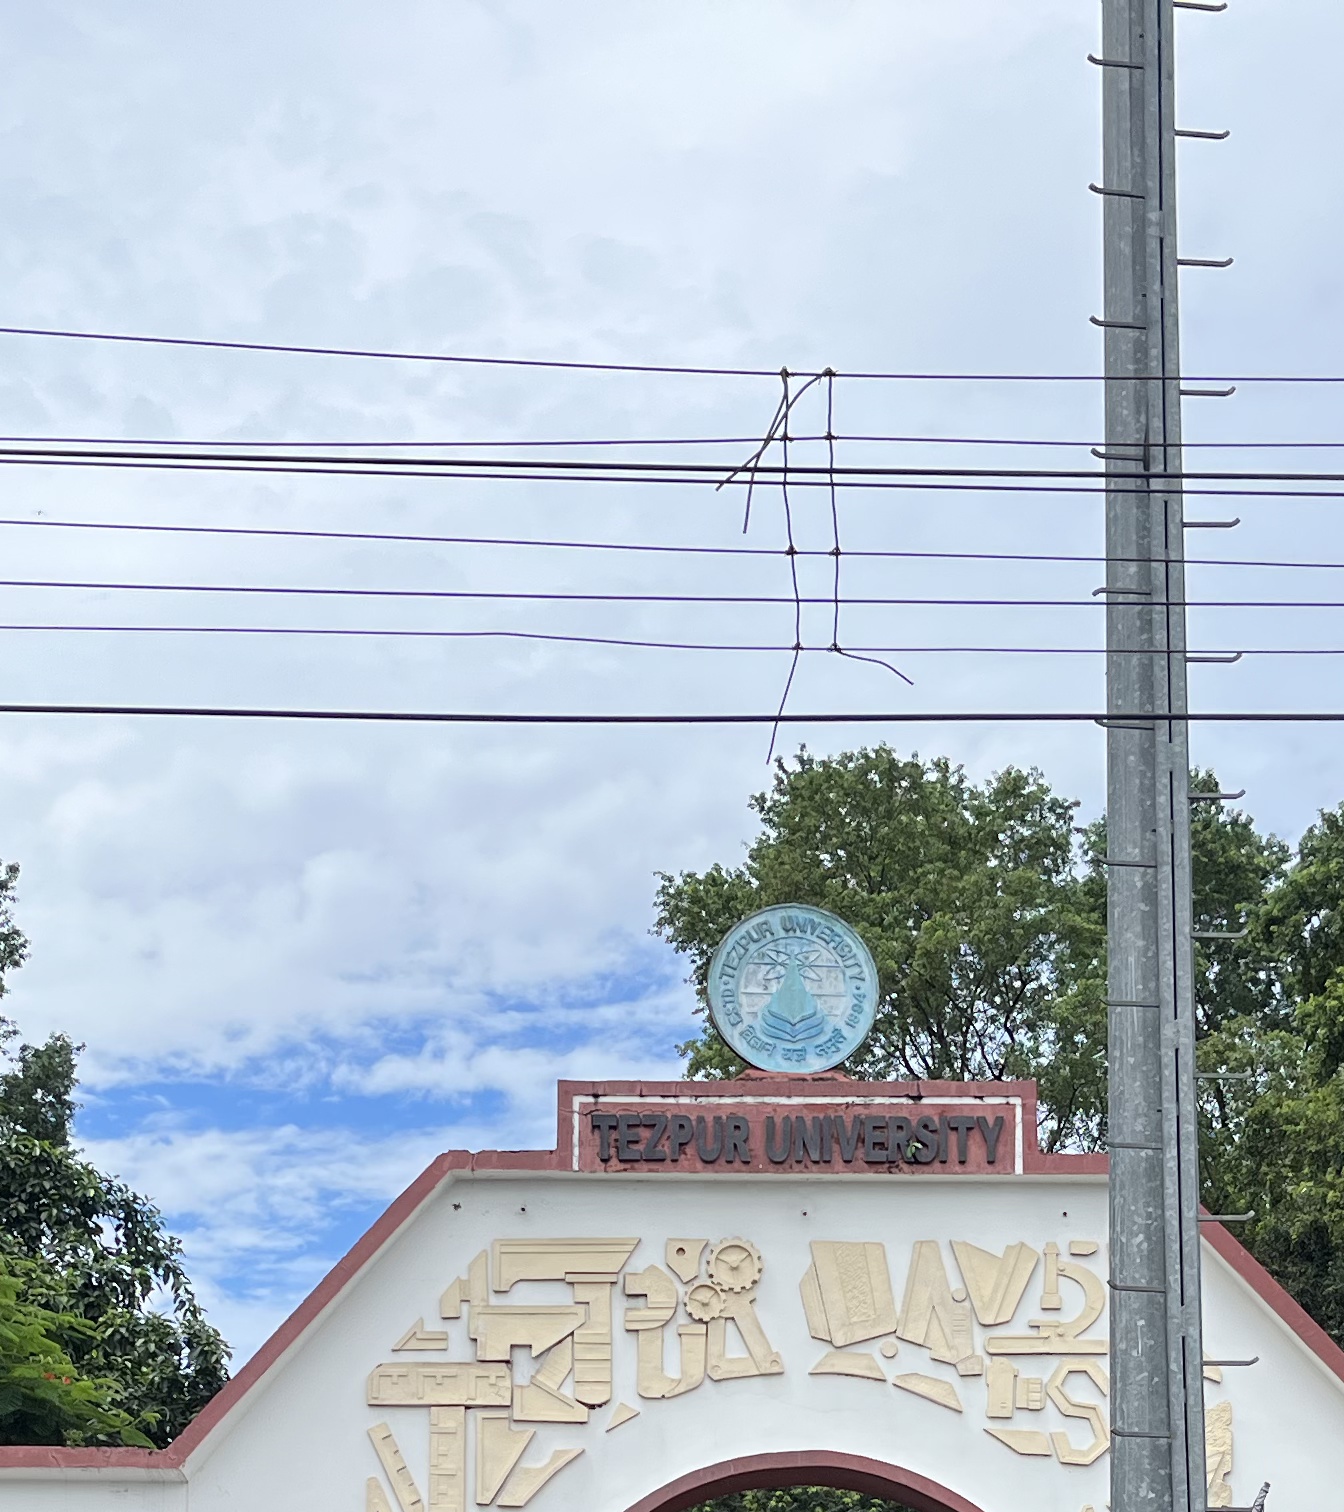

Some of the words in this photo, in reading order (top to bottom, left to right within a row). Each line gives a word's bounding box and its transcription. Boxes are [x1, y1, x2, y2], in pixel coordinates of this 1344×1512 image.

[719, 920, 774, 980] TEZPUR
[780, 916, 866, 982] UNIVERSITY
[590, 1113, 751, 1164] TEZPUR
[766, 1115, 1005, 1166] UNIVERSITY
